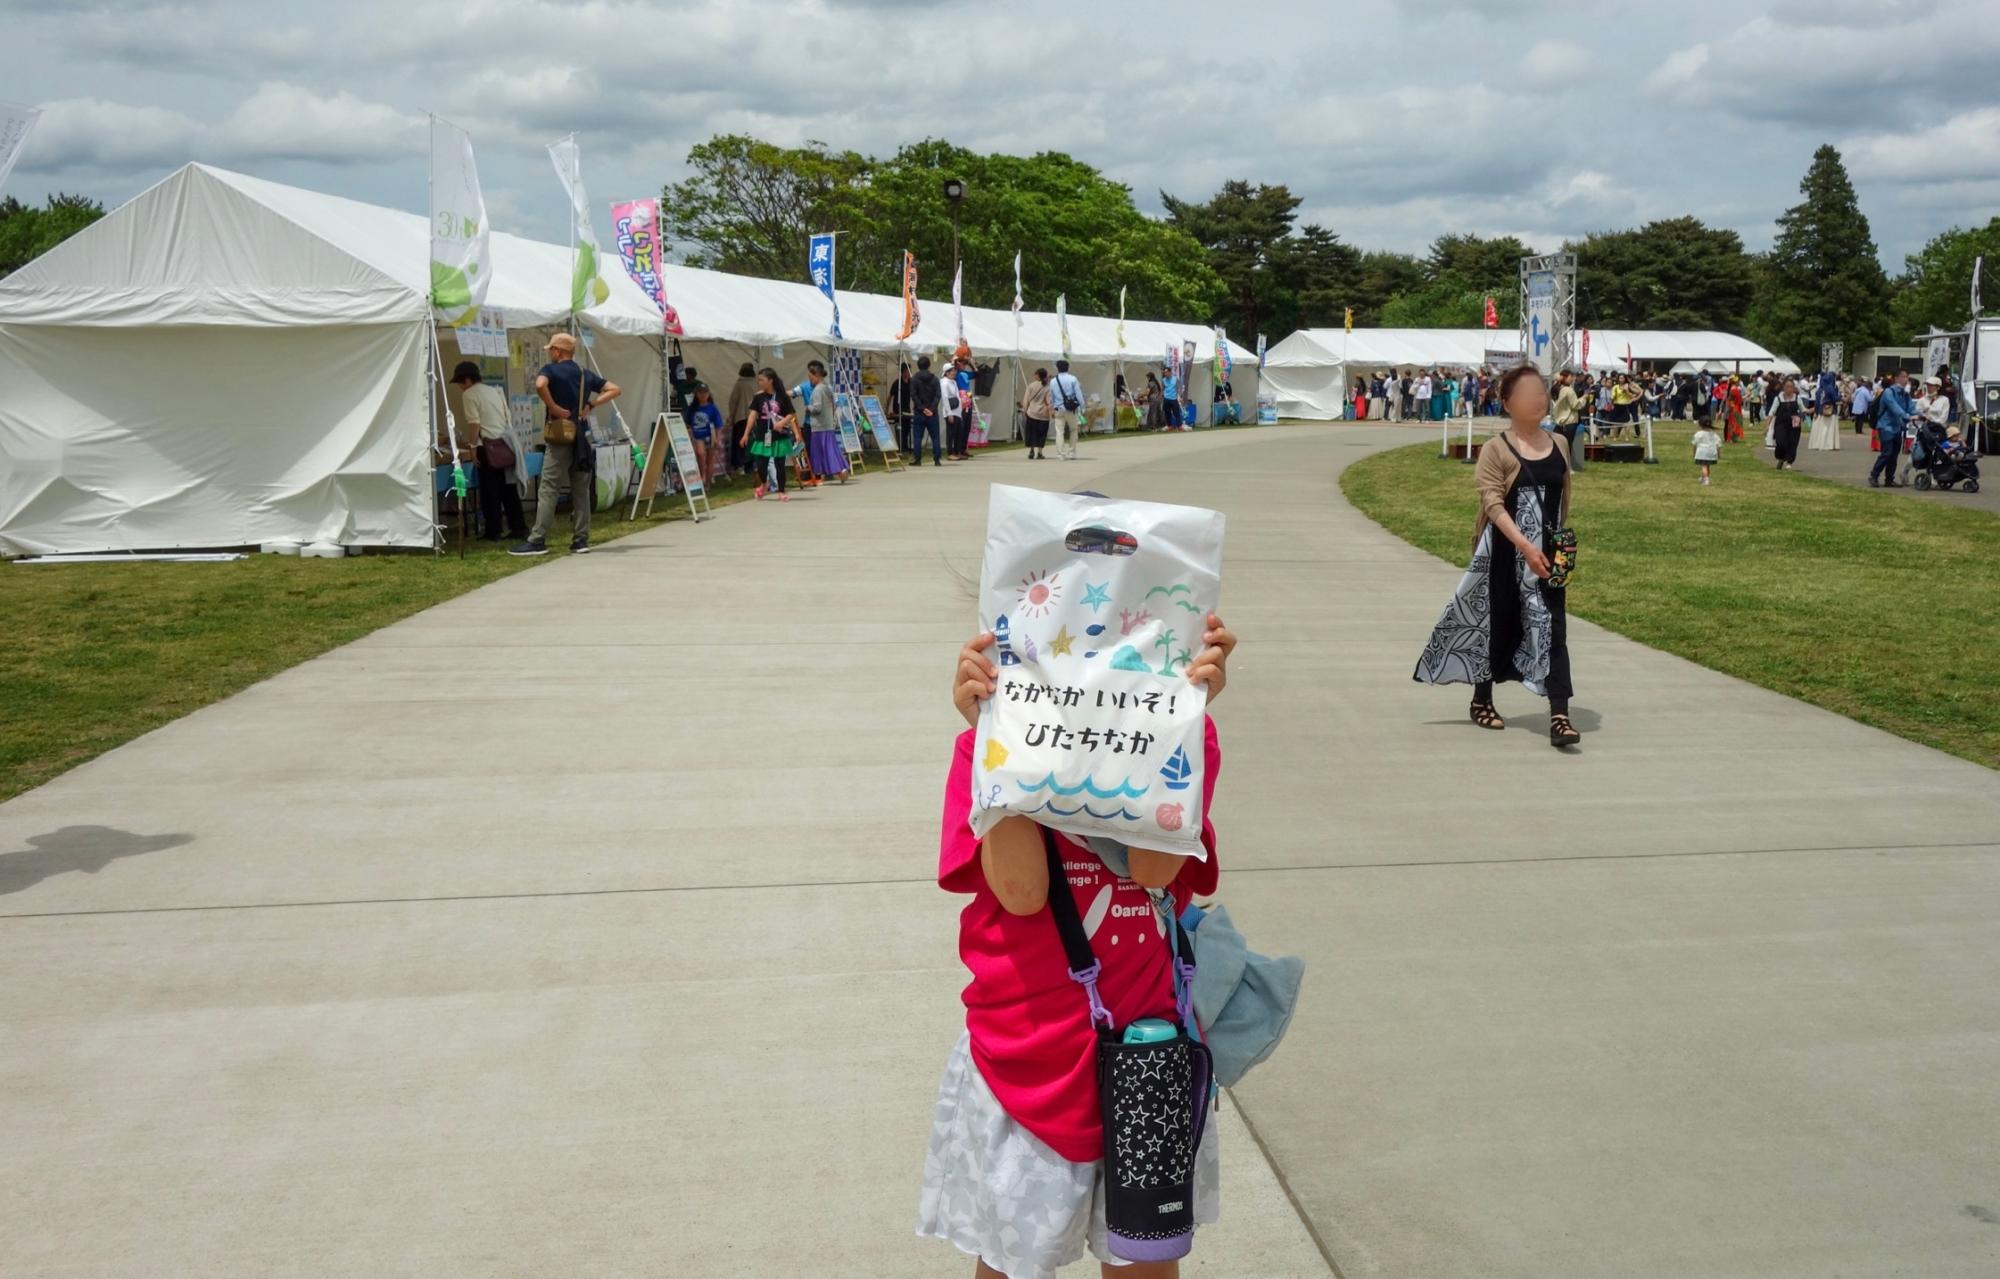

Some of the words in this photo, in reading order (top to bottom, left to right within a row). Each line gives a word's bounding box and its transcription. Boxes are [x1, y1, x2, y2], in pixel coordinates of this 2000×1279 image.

[1005, 681, 1085, 707] なかなか
[1096, 690, 1176, 714] いいぞ!
[1025, 723, 1154, 755] ひたちなか
[1111, 902, 1150, 918] Oarai
[1158, 1201, 1183, 1214] THERMOS
